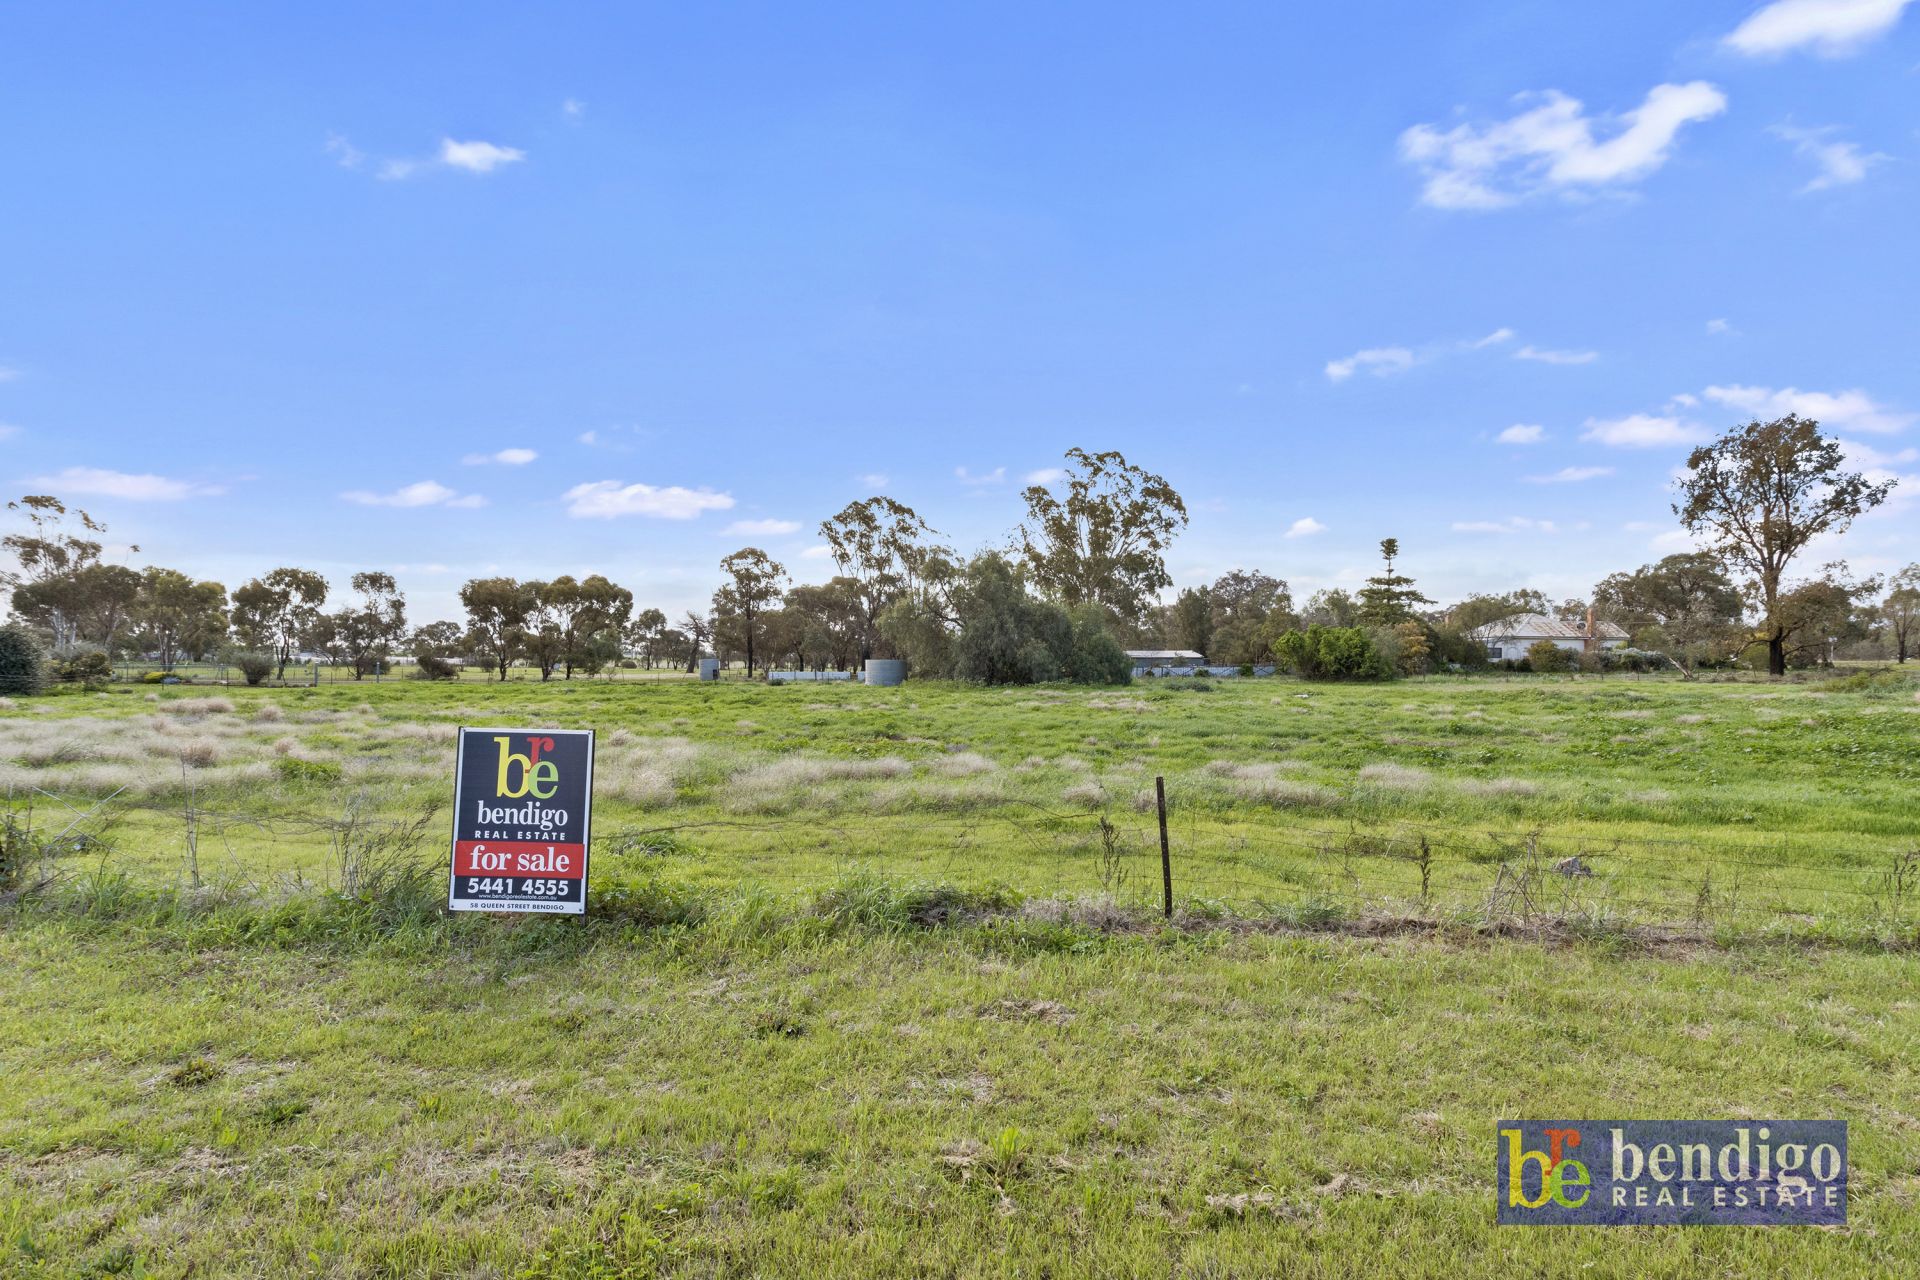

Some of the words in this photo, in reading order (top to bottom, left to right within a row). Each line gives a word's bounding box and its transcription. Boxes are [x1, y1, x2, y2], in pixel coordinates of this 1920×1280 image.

[477, 800, 568, 831] bendigo
[474, 830, 509, 839] REAL
[517, 831, 566, 841] ESTATE
[469, 845, 512, 871] for
[517, 847, 570, 872] sale
[467, 878, 513, 894] 5441
[521, 880, 569, 896] 4555
